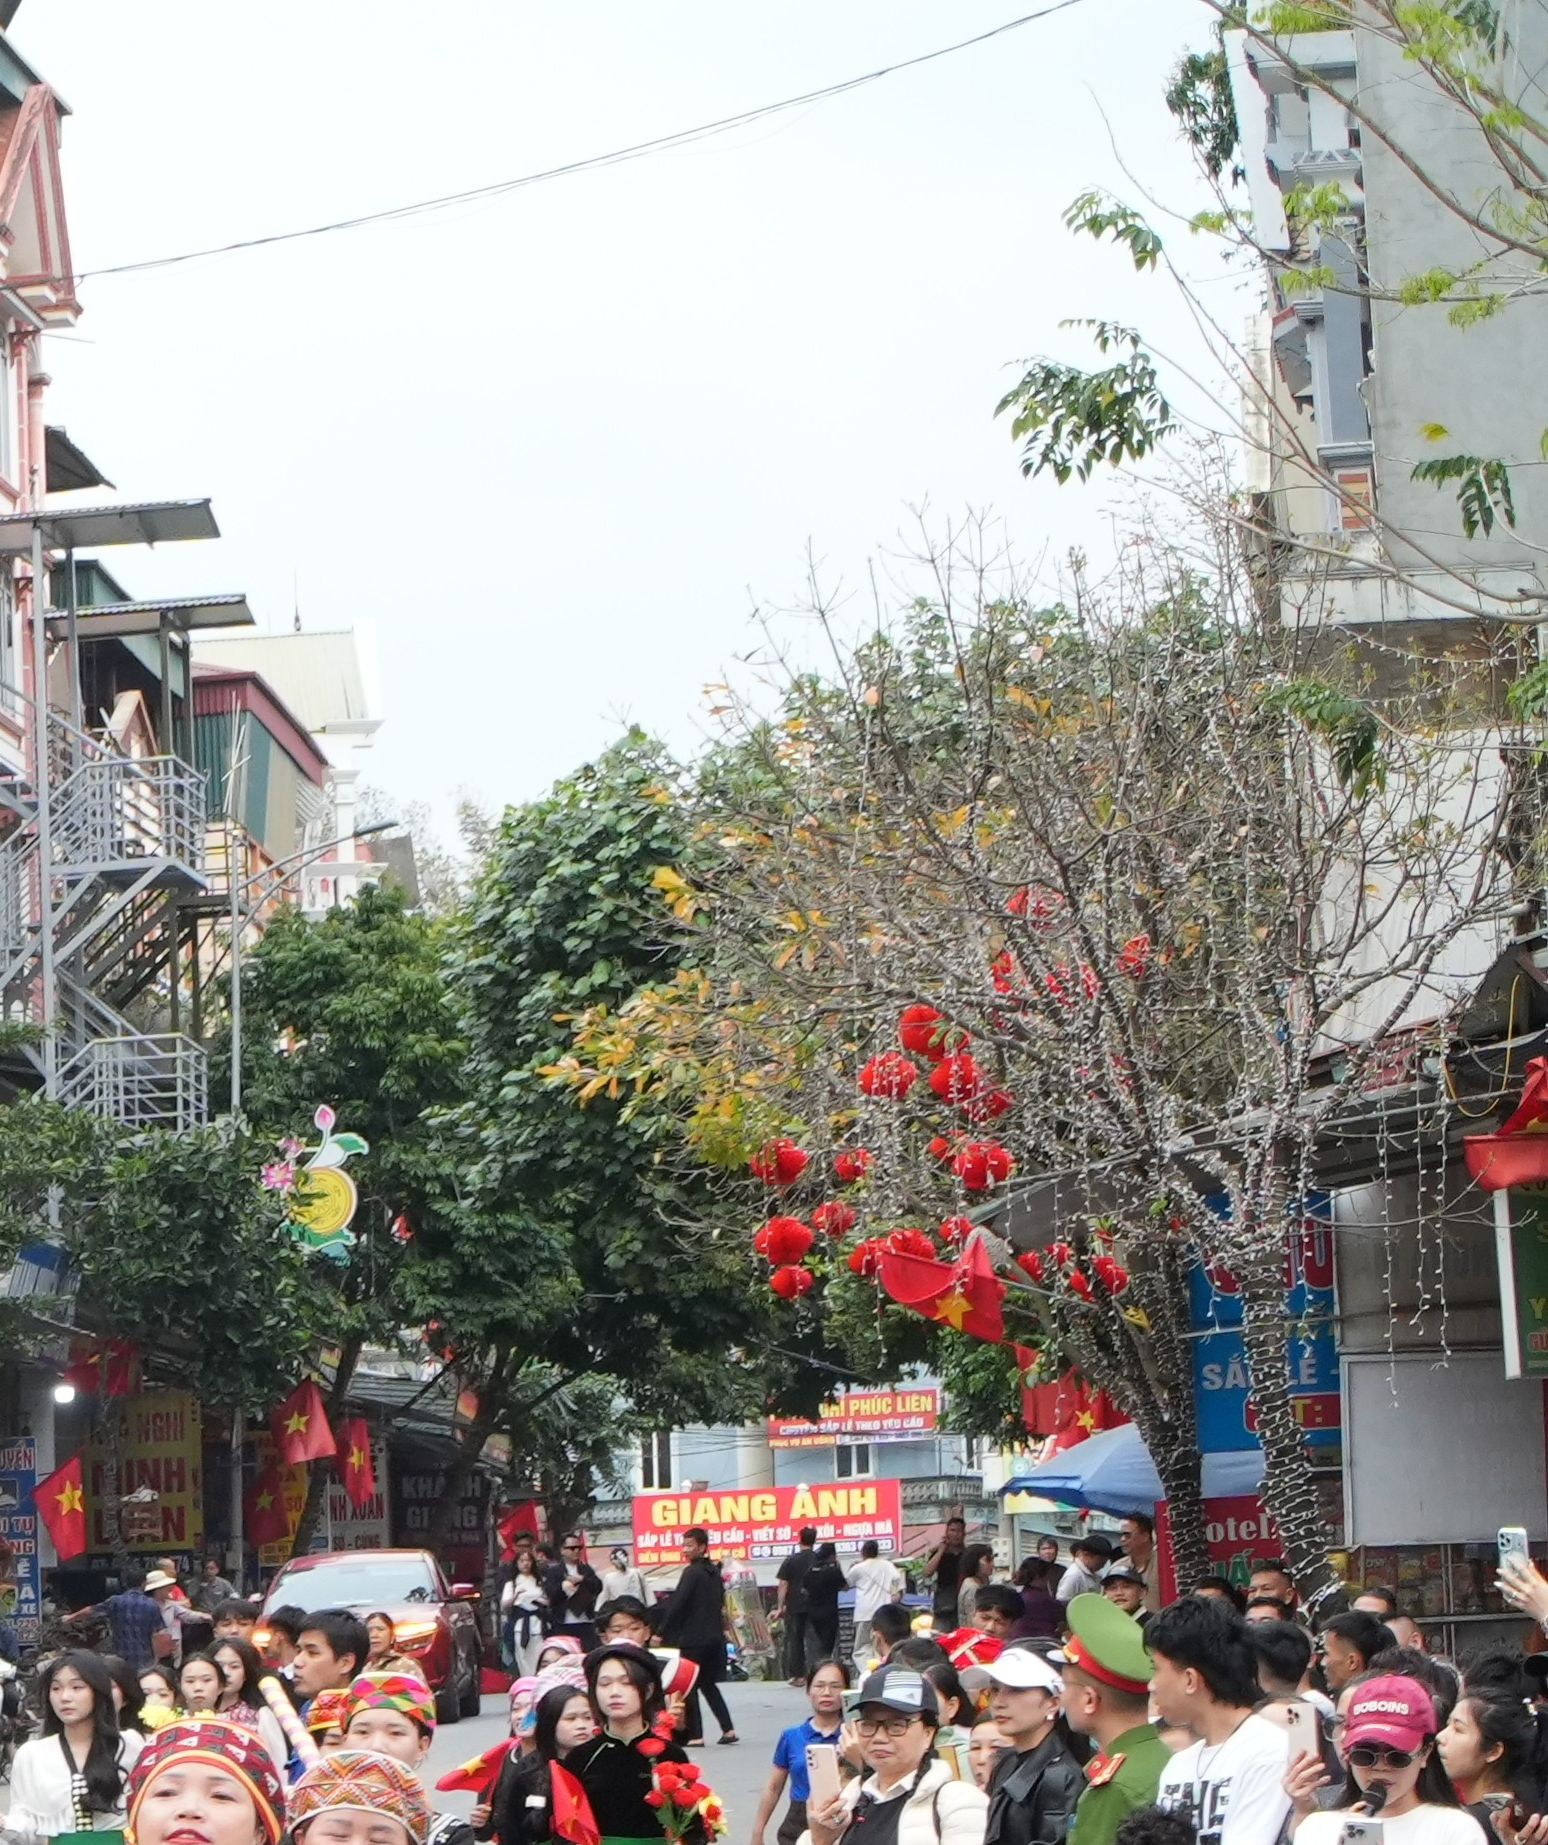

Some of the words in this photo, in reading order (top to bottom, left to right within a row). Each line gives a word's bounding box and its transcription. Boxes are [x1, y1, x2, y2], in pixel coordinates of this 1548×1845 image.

[849, 1393, 892, 1416] PHÚC
[651, 1492, 778, 1527] GIANG
[1205, 1512, 1271, 1543] otel
